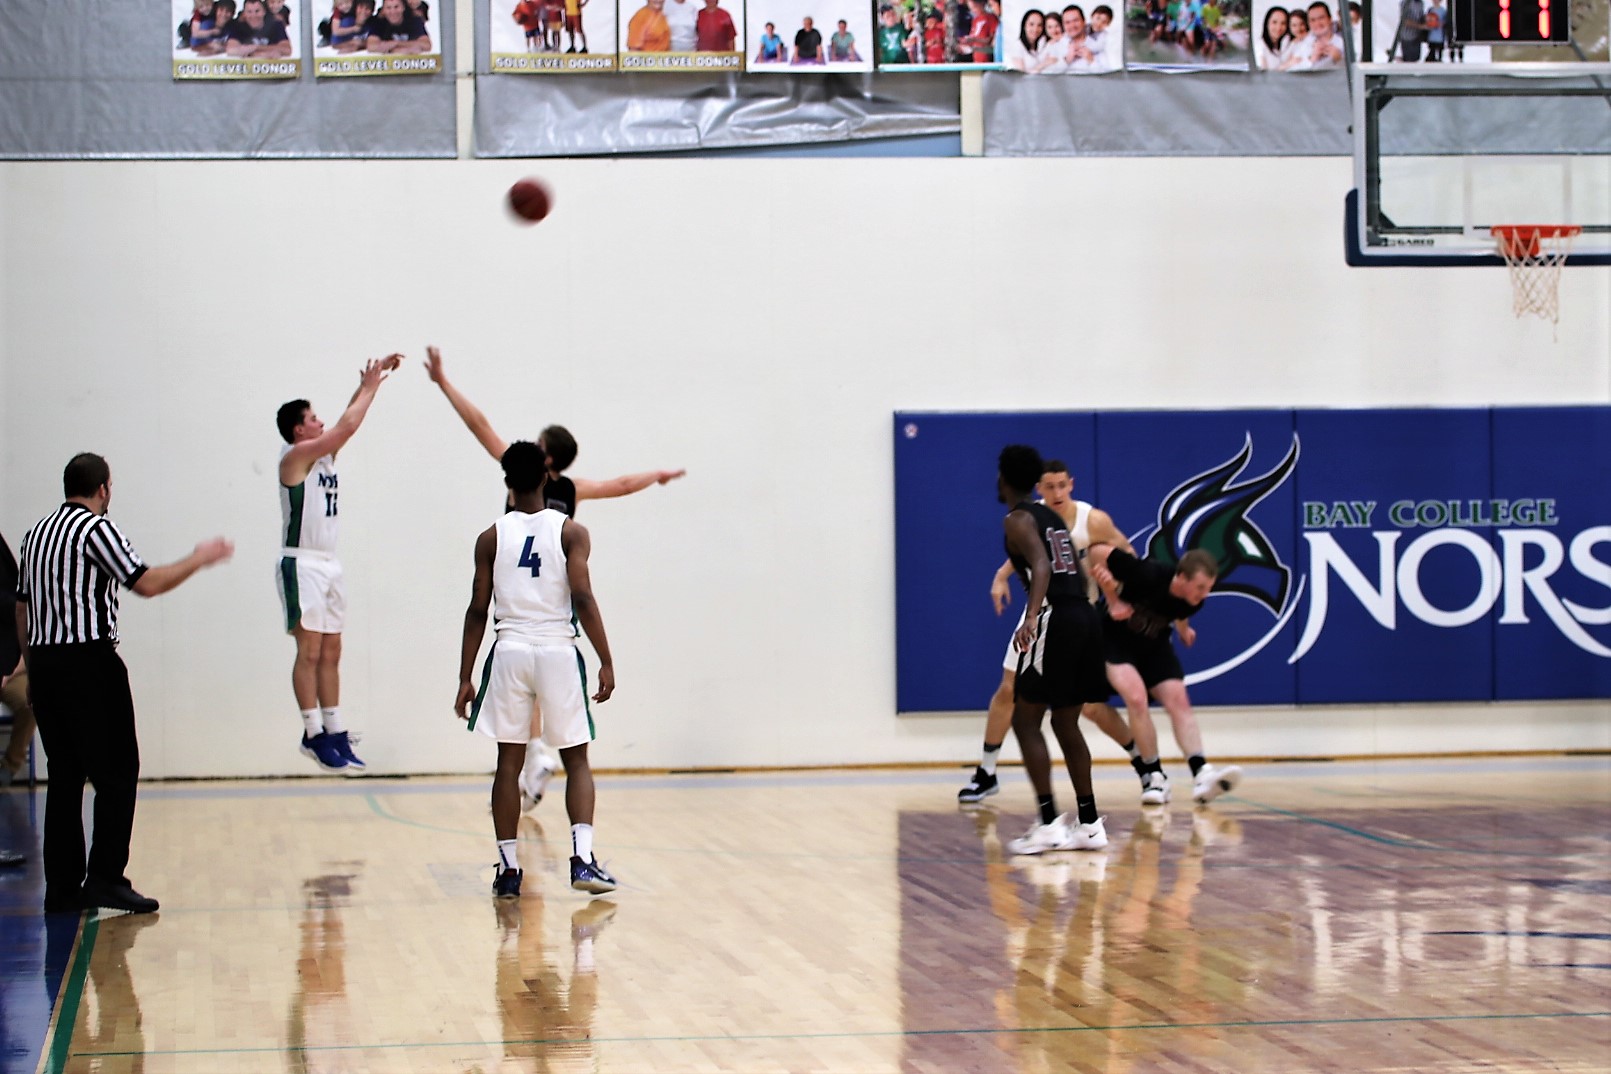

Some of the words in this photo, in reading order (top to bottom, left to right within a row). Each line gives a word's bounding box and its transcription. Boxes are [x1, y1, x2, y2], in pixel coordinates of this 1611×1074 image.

[178, 63, 210, 75] GOLD
[213, 63, 249, 75] LEVEL
[252, 63, 297, 74] DONOR
[319, 61, 352, 72] GOLD
[353, 60, 389, 71] LEVEL
[392, 58, 437, 70] DONOR
[496, 57, 528, 69] GOLD
[529, 57, 565, 69] LEVEL
[568, 58, 613, 68] DONOR
[623, 56, 655, 68] GOLD
[658, 56, 693, 67] LEVEL
[696, 56, 740, 67] DONOR
[1303, 501, 1377, 528] BAY
[1388, 498, 1559, 528] COLLEGE
[517, 535, 542, 578] 4
[1046, 527, 1078, 575] 15
[1287, 525, 1611, 665] NORS
